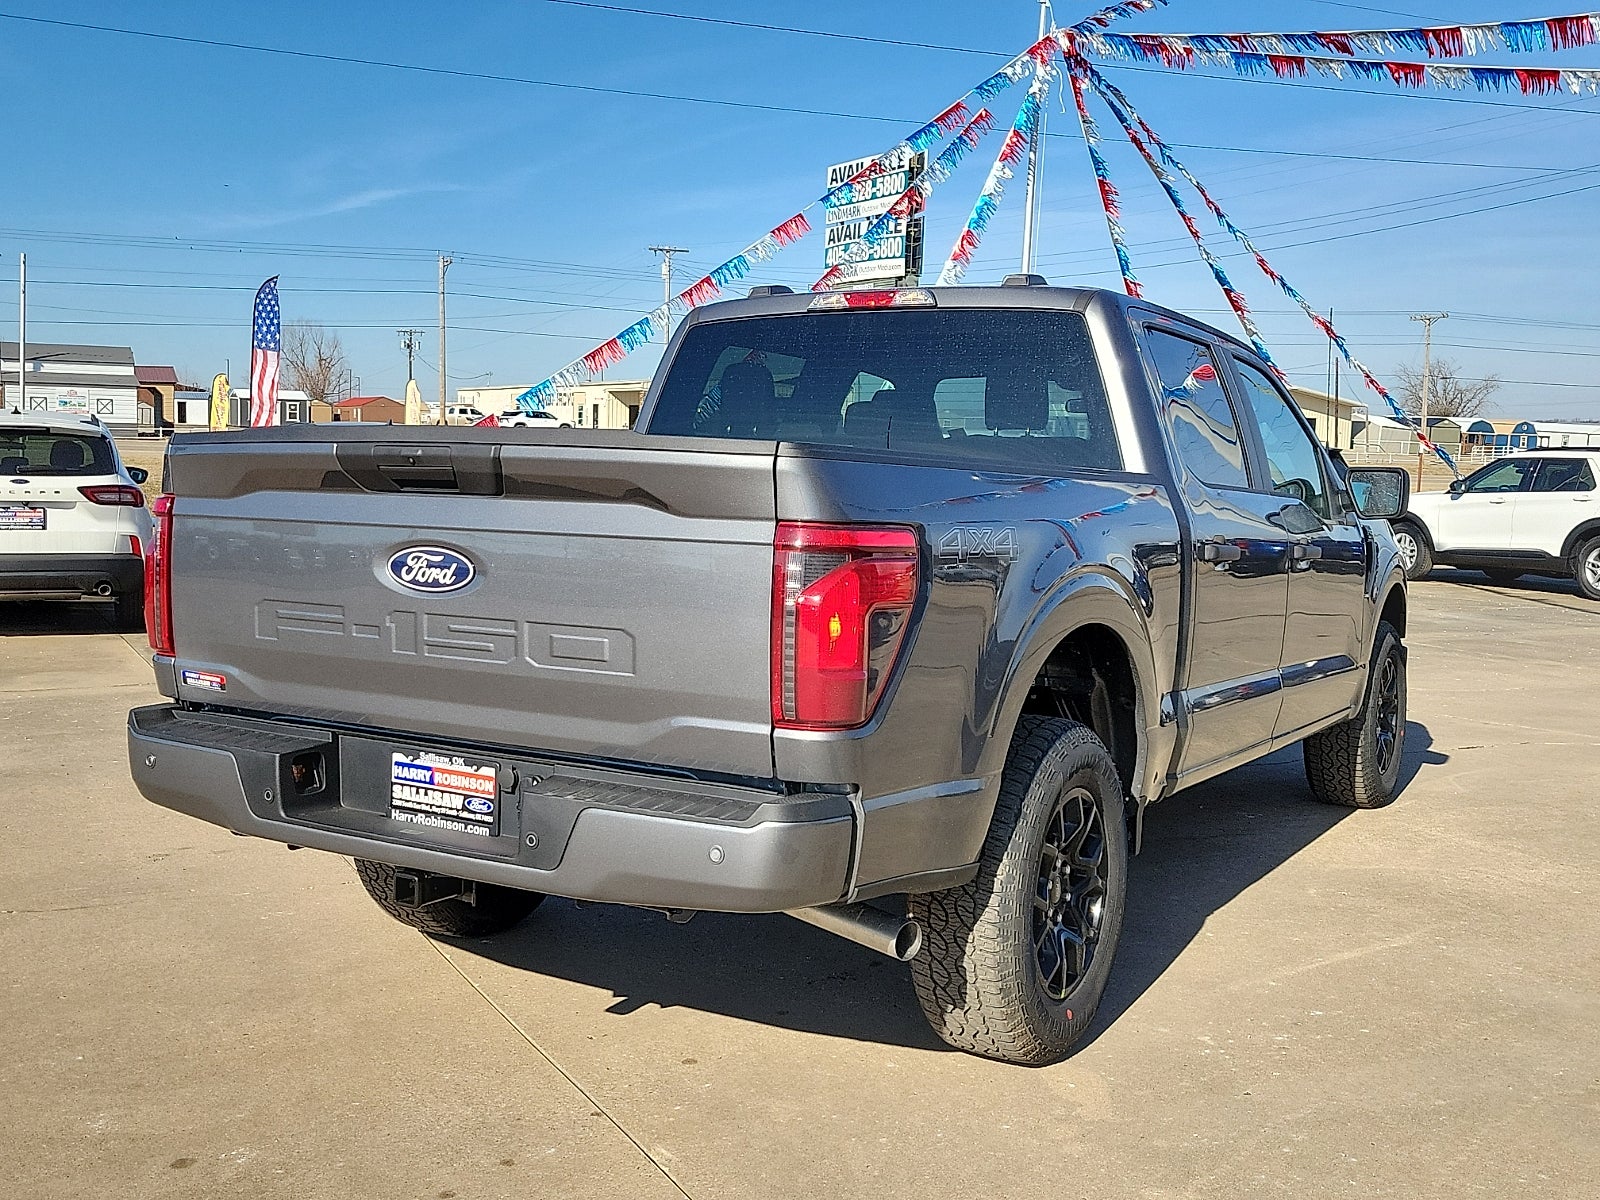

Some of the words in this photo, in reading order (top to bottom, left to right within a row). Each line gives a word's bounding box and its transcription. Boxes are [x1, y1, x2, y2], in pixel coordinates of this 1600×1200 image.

[400, 550, 457, 587] Ford
[254, 598, 637, 677] F-150
[419, 751, 451, 765] Sallisaw,
[452, 757, 465, 766] OK
[393, 765, 432, 782] HARRY
[434, 771, 494, 792] ROBINSON
[392, 784, 465, 810] SALLISAW
[391, 809, 490, 836] HarryRobinson.com
